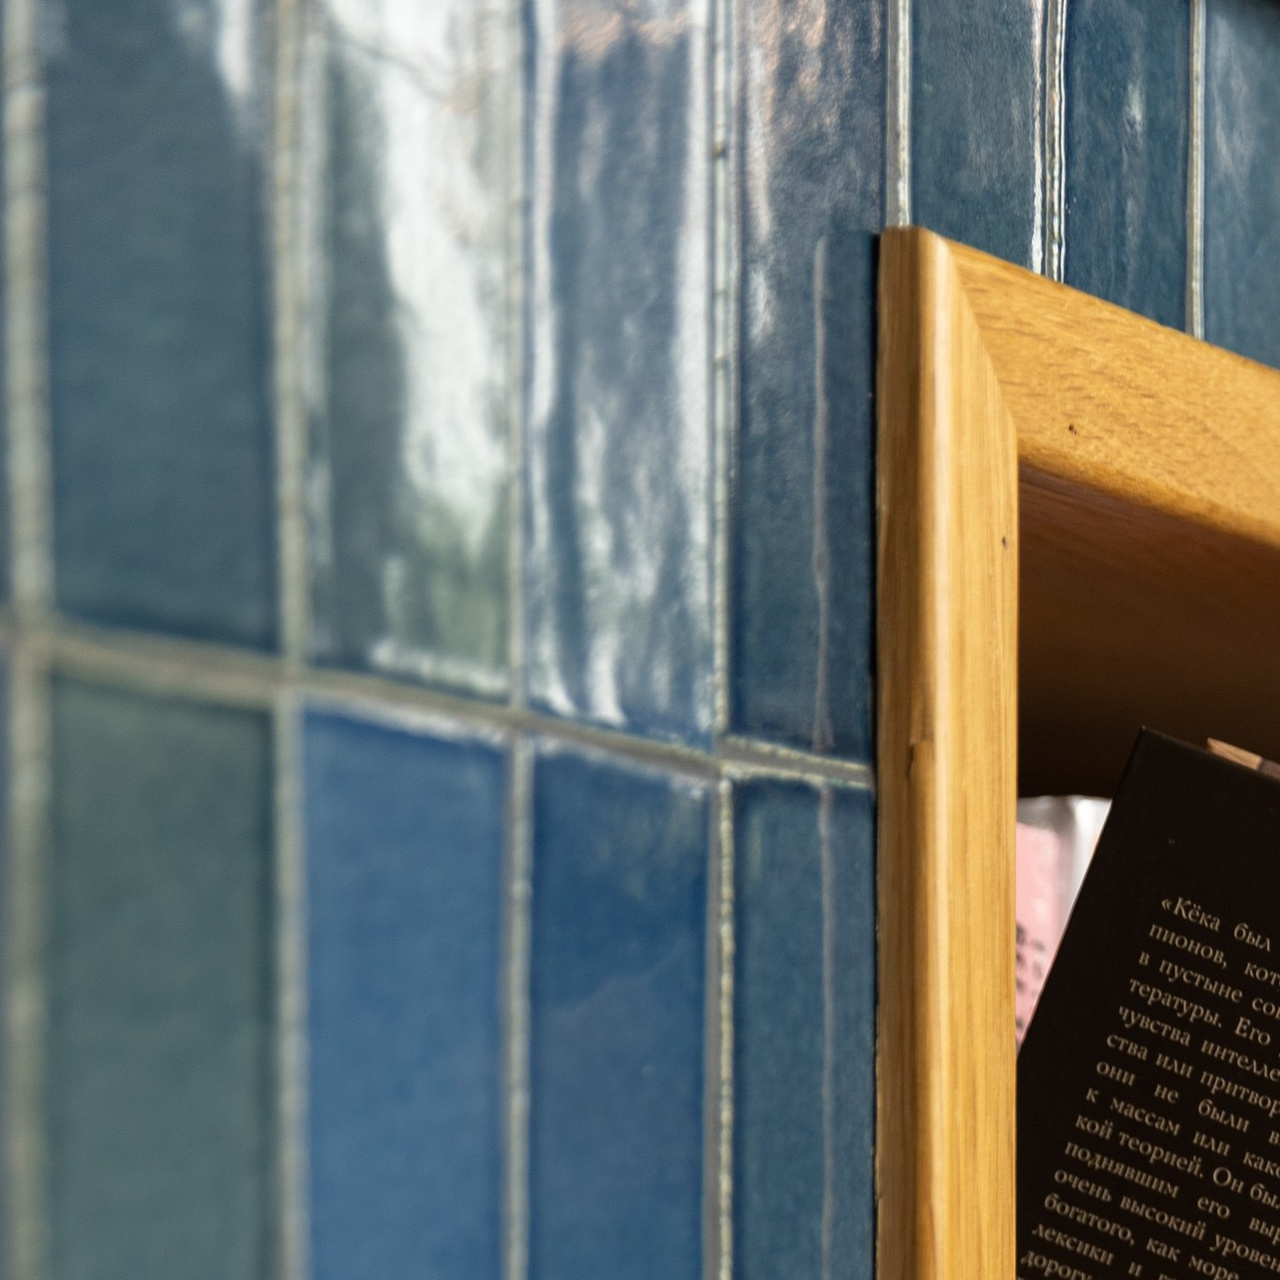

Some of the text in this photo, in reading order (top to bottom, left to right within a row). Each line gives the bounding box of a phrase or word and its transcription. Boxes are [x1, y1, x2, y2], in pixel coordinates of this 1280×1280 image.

[1149, 924, 1226, 968] пионов,
[1161, 896, 1220, 931] «Кёка
[1233, 922, 1270, 952] был
[1138, 951, 1149, 965] в
[1158, 959, 1242, 1002] пустыне
[1118, 1005, 1190, 1046] чувства
[1129, 978, 1221, 1027] тературы.
[1234, 1016, 1270, 1045] Его
[1106, 1034, 1147, 1060] ства
[1155, 1053, 1192, 1078] или
[1085, 1087, 1098, 1103] к
[1110, 1097, 1180, 1136] массам
[1192, 1131, 1230, 1156] или
[1096, 1061, 1135, 1086] они
[1154, 1084, 1178, 1103] не
[1198, 1098, 1249, 1132] были
[1064, 1141, 1178, 1198] поднявшим
[1197, 1197, 1230, 1218] его
[1075, 1114, 1113, 1139] кой
[1118, 1131, 1203, 1178] теорией.
[1212, 1166, 1244, 1193] Он
[1044, 1192, 1134, 1245] богатого,
[1145, 1237, 1180, 1261] как
[1054, 1169, 1111, 1201] очень
[1119, 1195, 1206, 1240] высокий
[1031, 1223, 1113, 1265] лексики
[1128, 1262, 1142, 1277] и
